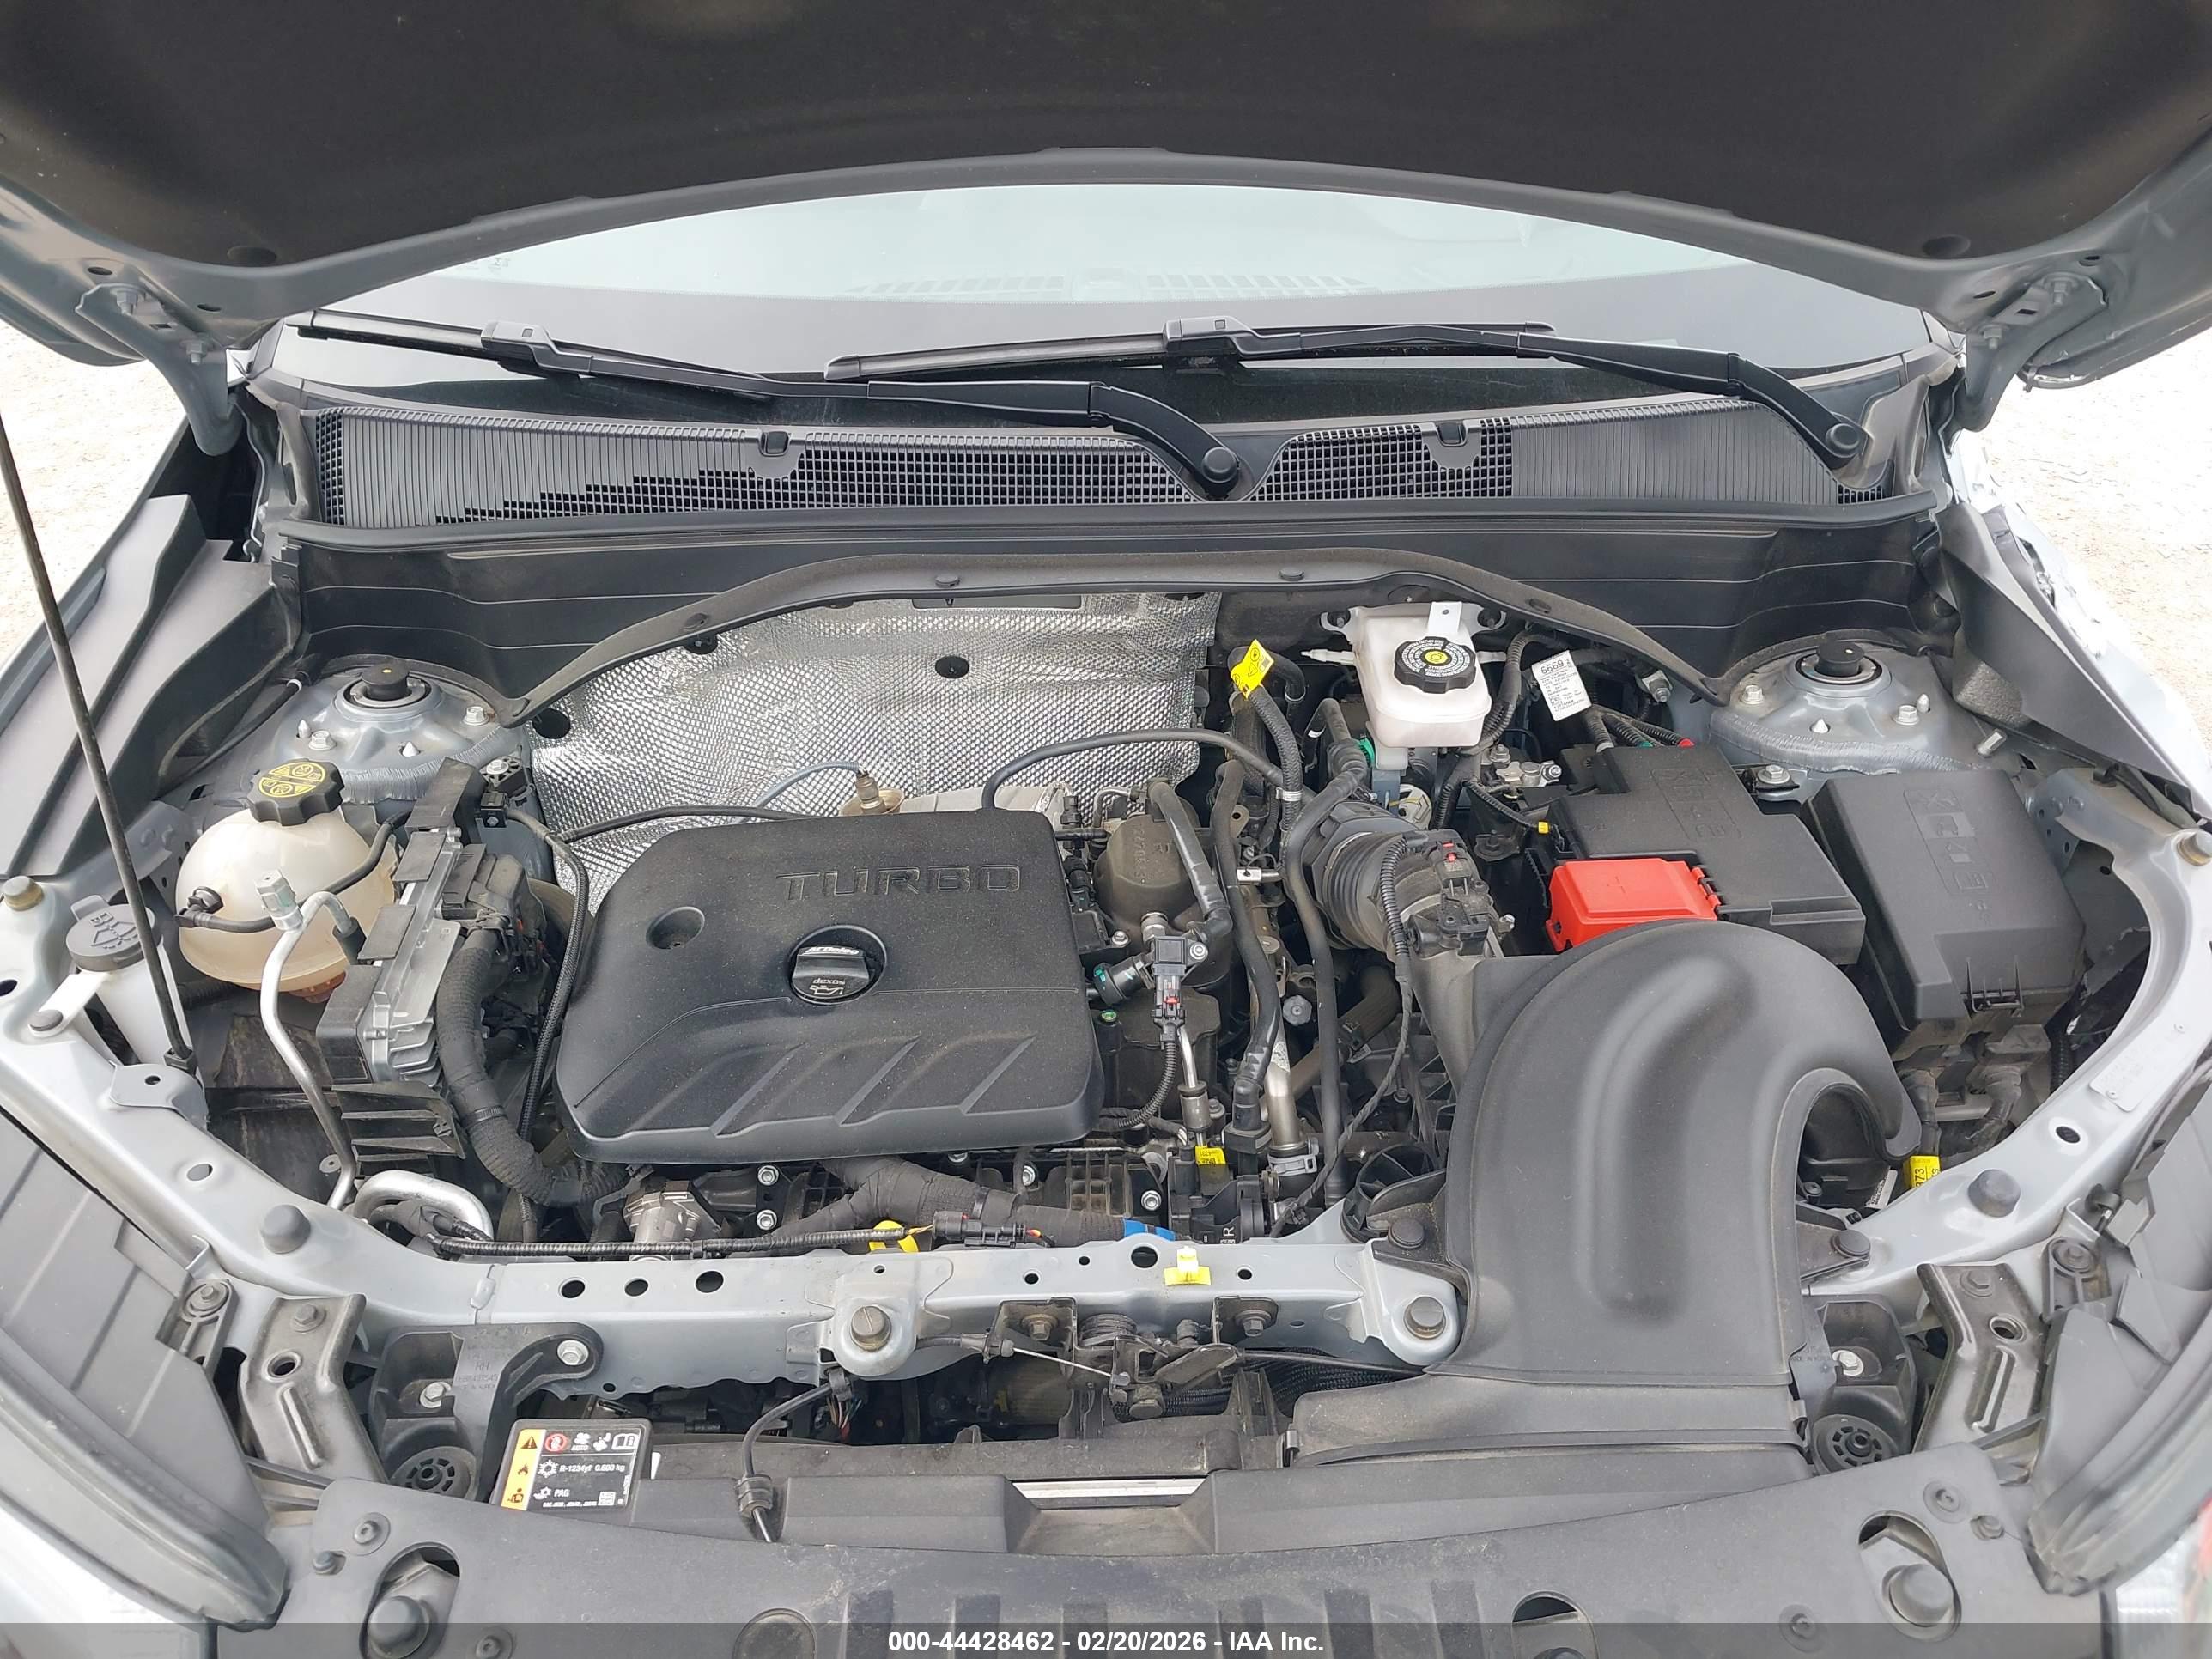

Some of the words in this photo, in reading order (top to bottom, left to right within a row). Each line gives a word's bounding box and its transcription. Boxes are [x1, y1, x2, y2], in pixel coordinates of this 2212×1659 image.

[1540, 659, 1565, 674] 6669
[775, 864, 1020, 901] TURBO
[616, 1462, 626, 1473] kg
[554, 1488, 570, 1498] PAG
